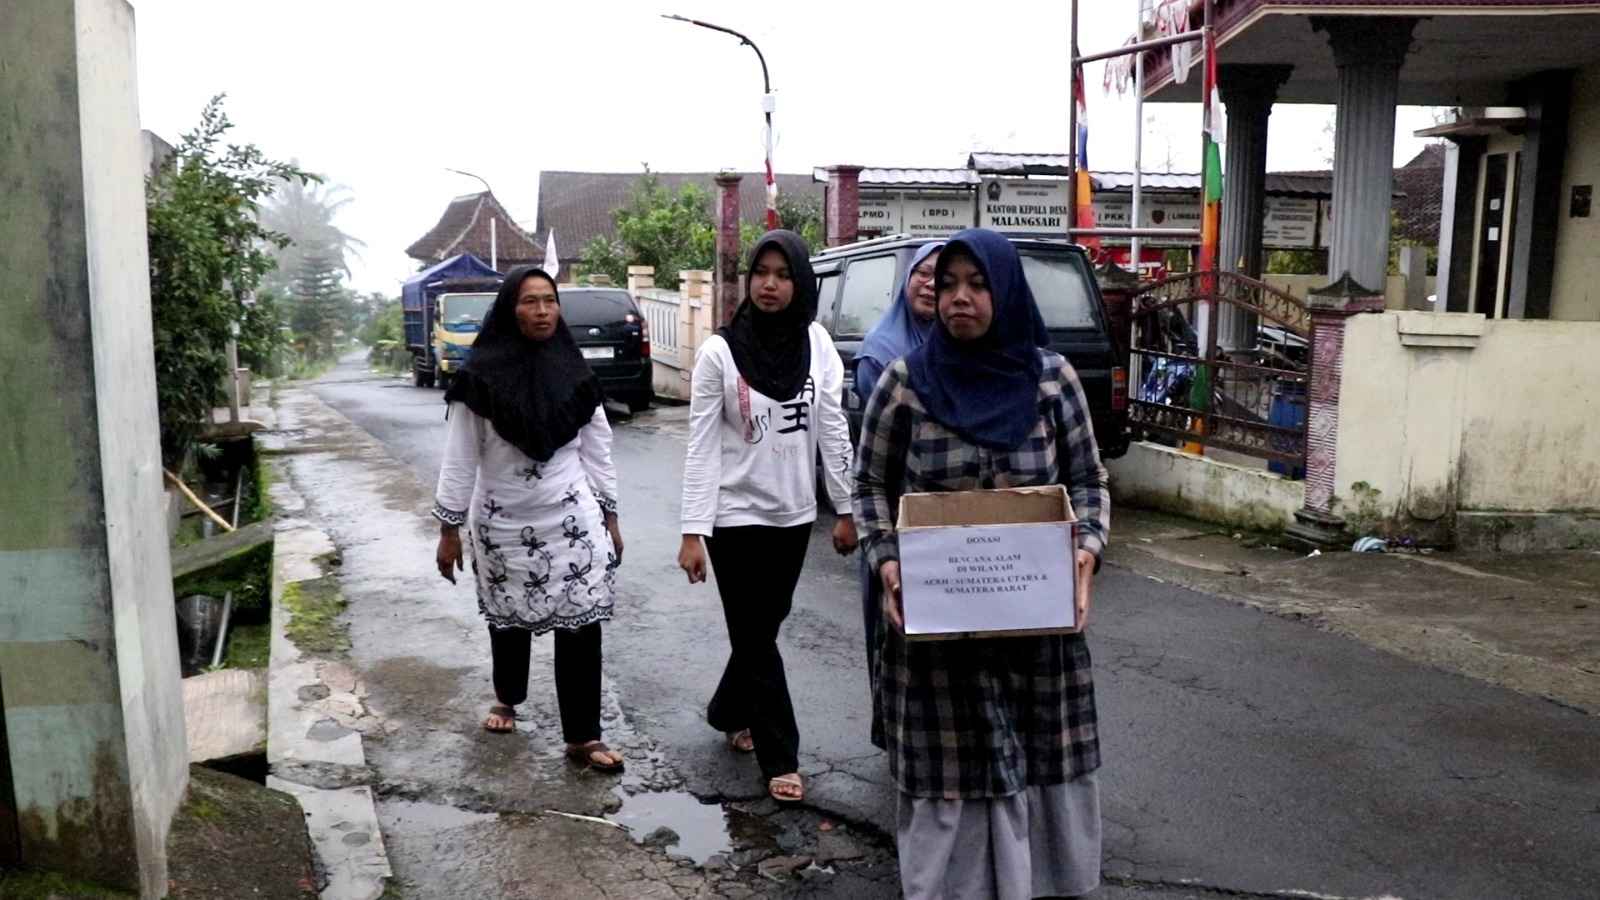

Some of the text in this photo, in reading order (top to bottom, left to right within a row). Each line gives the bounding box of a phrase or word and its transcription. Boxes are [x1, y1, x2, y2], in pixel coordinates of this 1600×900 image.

[986, 204, 1068, 215] KANTOR KEPALA DESA
[991, 215, 1061, 227] MALANGSARI
[966, 536, 1001, 545] DONASI
[995, 553, 1022, 562] ALAM
[997, 584, 1028, 593] BARAT
